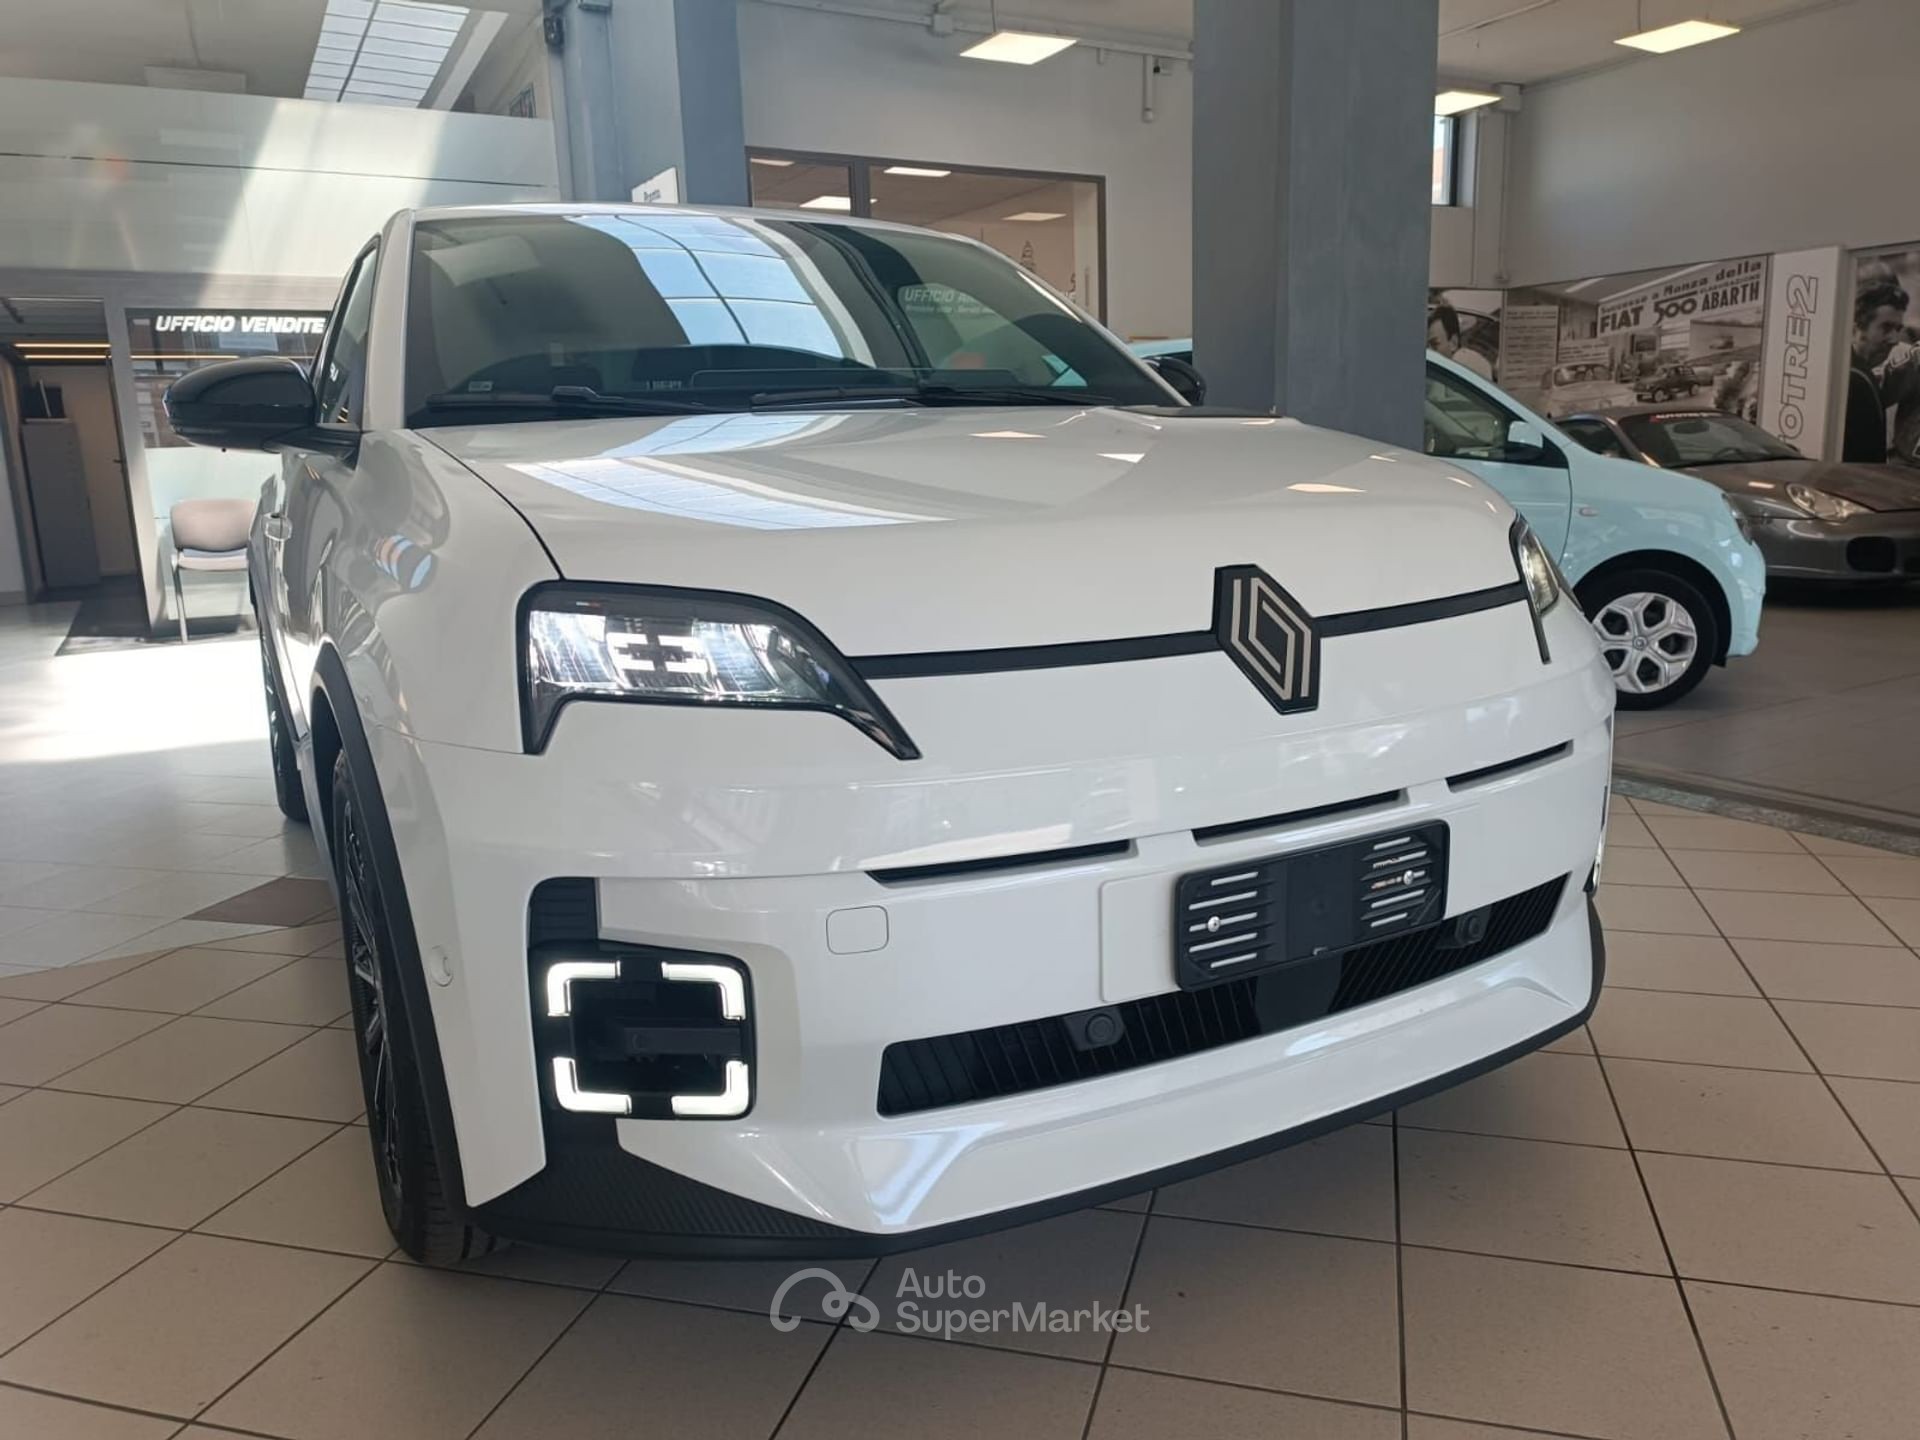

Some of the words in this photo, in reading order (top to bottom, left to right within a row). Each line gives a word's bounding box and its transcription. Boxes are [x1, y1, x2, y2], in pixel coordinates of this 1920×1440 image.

[1716, 261, 1761, 281] della
[905, 287, 955, 303] UFFICIO
[1600, 306, 1644, 333] FIAT
[1653, 291, 1698, 327] 500
[1702, 281, 1759, 312] ABARTH
[155, 315, 236, 332] UFFICIO
[241, 316, 326, 334] VENDITE
[1777, 274, 1818, 443] OTRE2
